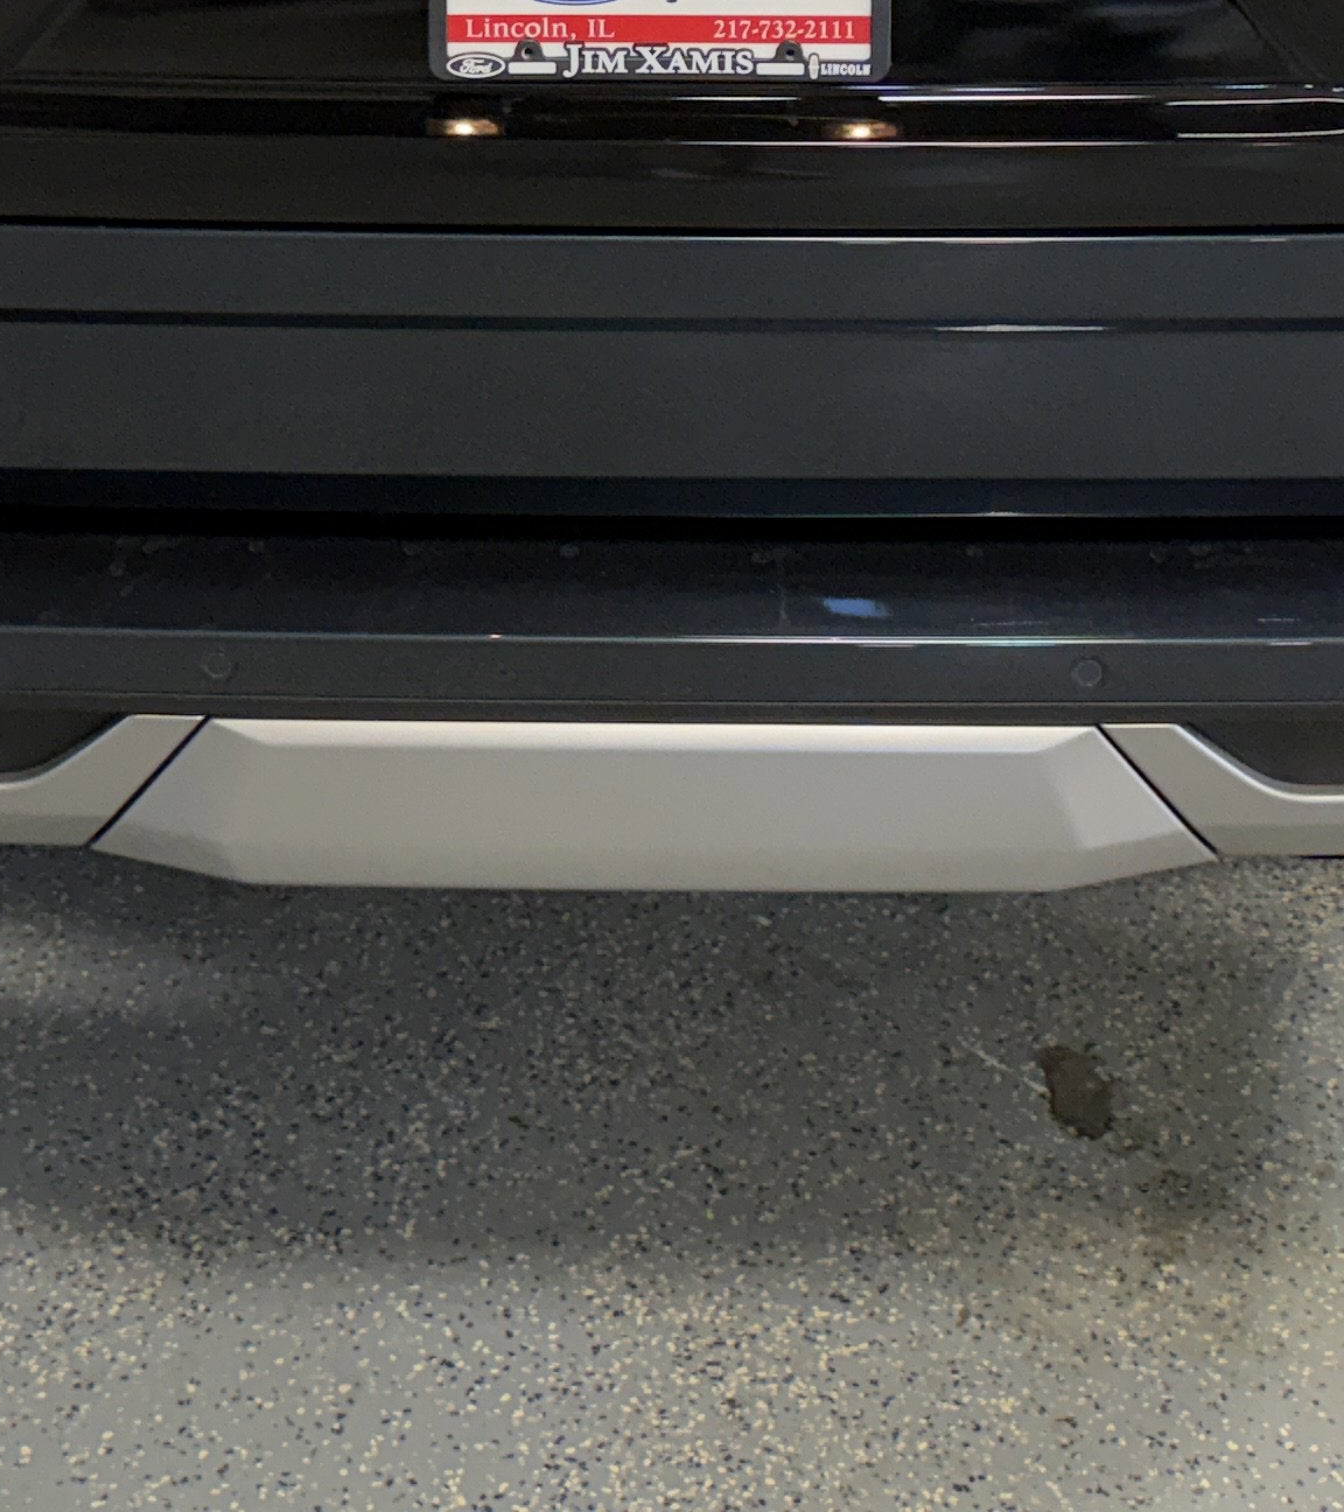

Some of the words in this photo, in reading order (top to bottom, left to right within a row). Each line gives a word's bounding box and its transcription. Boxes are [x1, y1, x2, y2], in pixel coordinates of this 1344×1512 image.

[466, 18, 577, 40] Lincoln,
[587, 19, 615, 38] IL
[713, 19, 855, 39] 217-732-2111
[460, 58, 494, 74] Ford
[562, 44, 628, 78] JIM
[634, 45, 754, 75] XAMIS
[820, 64, 871, 76] LINCOLN
